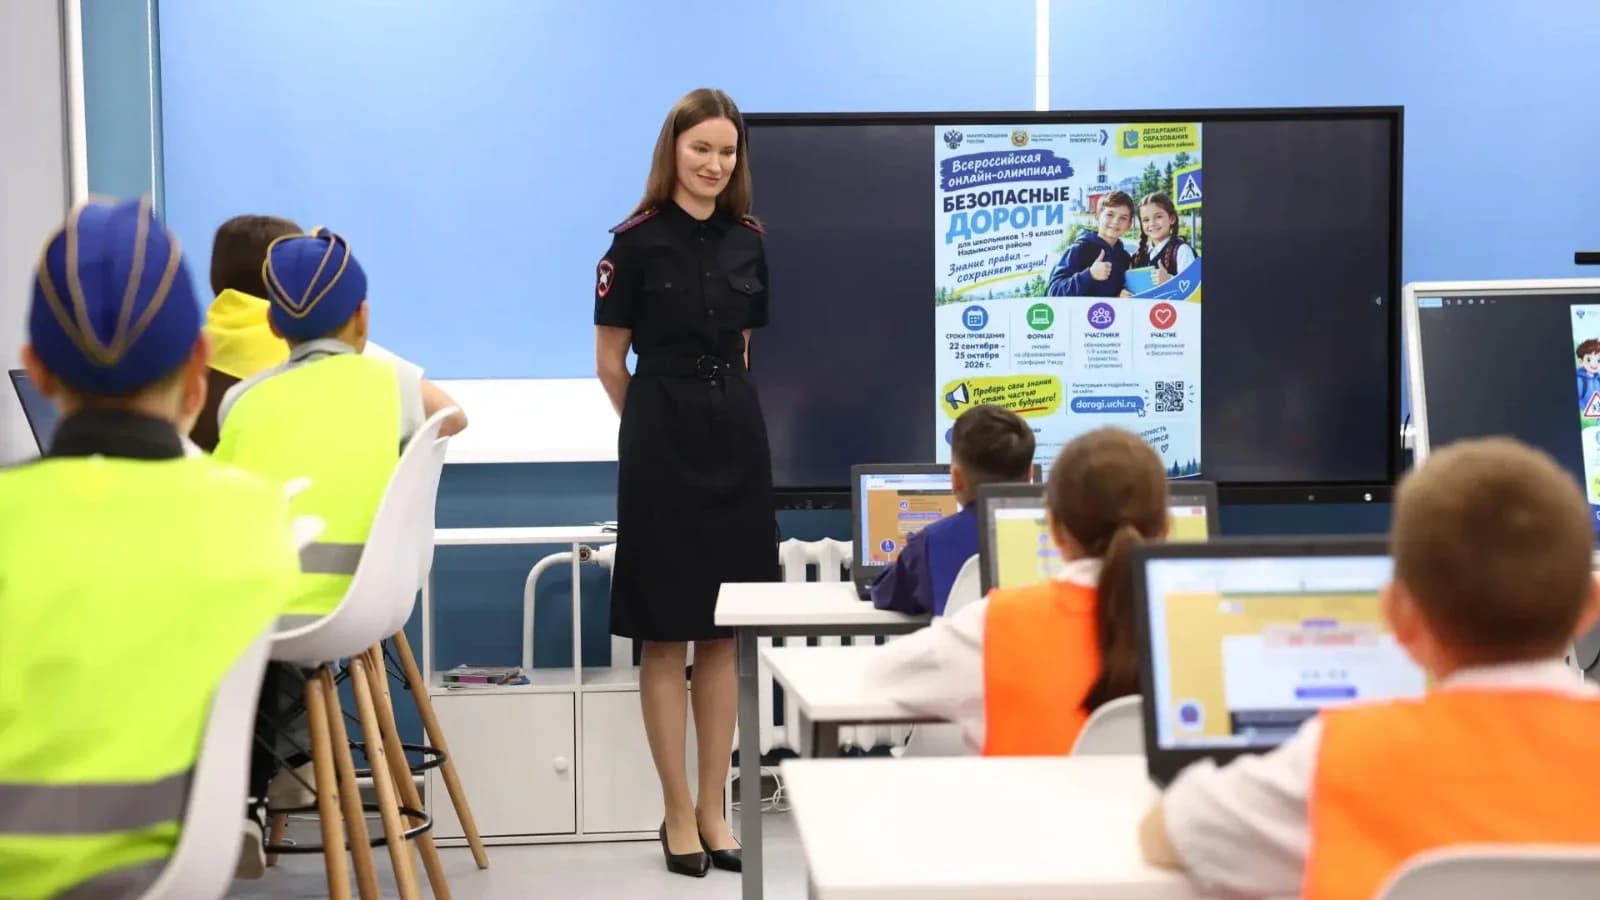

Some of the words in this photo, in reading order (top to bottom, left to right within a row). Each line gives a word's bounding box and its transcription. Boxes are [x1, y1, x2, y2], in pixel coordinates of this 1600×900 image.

[1143, 127, 1187, 135] ДЕПАРТАМЕНТ
[952, 152, 1041, 174] Всероссийская
[948, 165, 1062, 188] онлайн-олимпиада
[944, 186, 1070, 212] БЕЗОПАСНЫЕ
[945, 204, 1064, 244] ДОРОГИ
[972, 234, 1018, 246] школьников
[1036, 229, 1064, 238] классов
[958, 244, 1004, 256] Надымского
[1006, 242, 1032, 250] района
[948, 260, 984, 276] Знание
[988, 253, 1020, 266] правил
[957, 266, 1012, 282] сохраняет
[1016, 254, 1048, 272] жизни!
[961, 342, 998, 350] сентября
[967, 352, 999, 360] октября
[974, 386, 1005, 396] Проверь
[1028, 379, 1052, 387] знания
[982, 396, 1006, 404] стань
[1008, 390, 1036, 398] частью
[1018, 393, 1056, 408] будущего!
[1076, 400, 1136, 410] dorogi.uchi.ru
